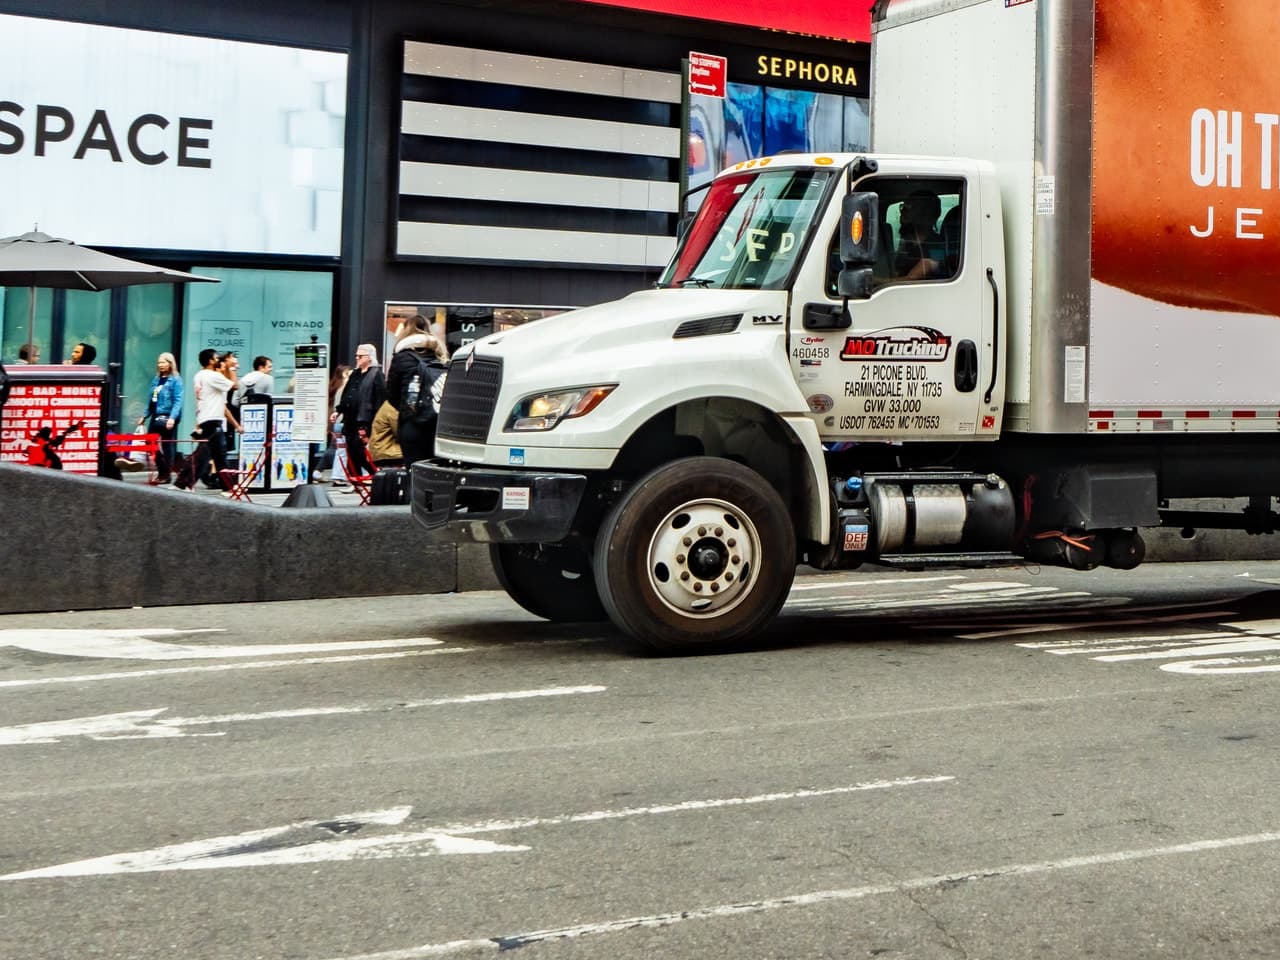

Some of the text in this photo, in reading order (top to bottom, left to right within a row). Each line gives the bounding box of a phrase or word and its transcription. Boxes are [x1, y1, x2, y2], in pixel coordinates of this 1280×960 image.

[758, 55, 857, 86] SEPHORA
[0, 101, 214, 169] SPACE
[1190, 108, 1242, 188] OH
[792, 348, 830, 359] 460458
[861, 366, 928, 380] 21 PICONE BLVD.
[844, 382, 943, 398] FARMINGDALE, NY 11735
[864, 400, 921, 414] GVW 33,000
[840, 416, 866, 429] USDOT
[868, 416, 895, 429] 762455
[846, 533, 867, 543] DEF
